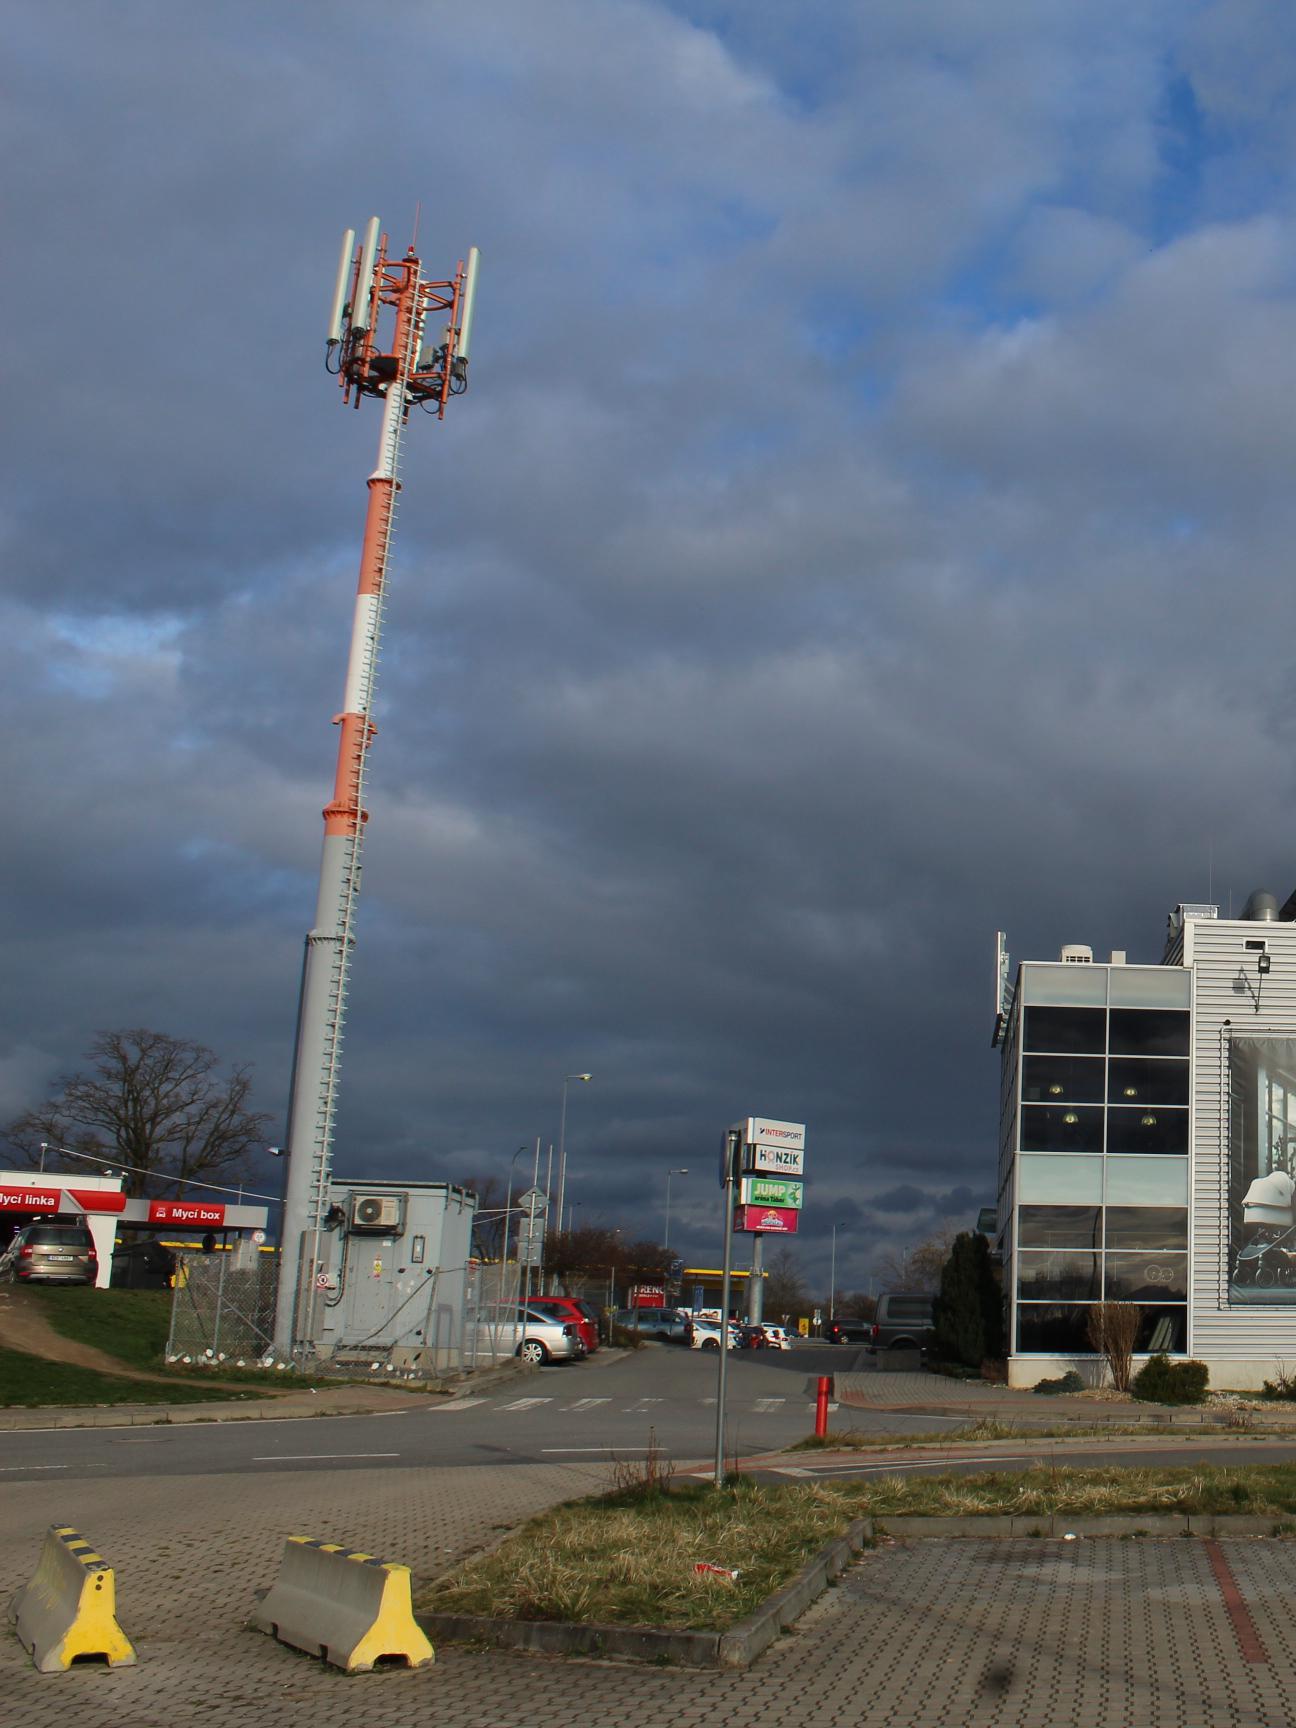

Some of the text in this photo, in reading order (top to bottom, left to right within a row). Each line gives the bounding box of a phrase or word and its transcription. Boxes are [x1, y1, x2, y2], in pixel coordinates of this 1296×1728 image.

[765, 1127, 803, 1140] INTERSPORT
[754, 1182, 786, 1197] JUMP
[25, 1194, 55, 1206] linka
[172, 1208, 220, 1220] Mycí box
